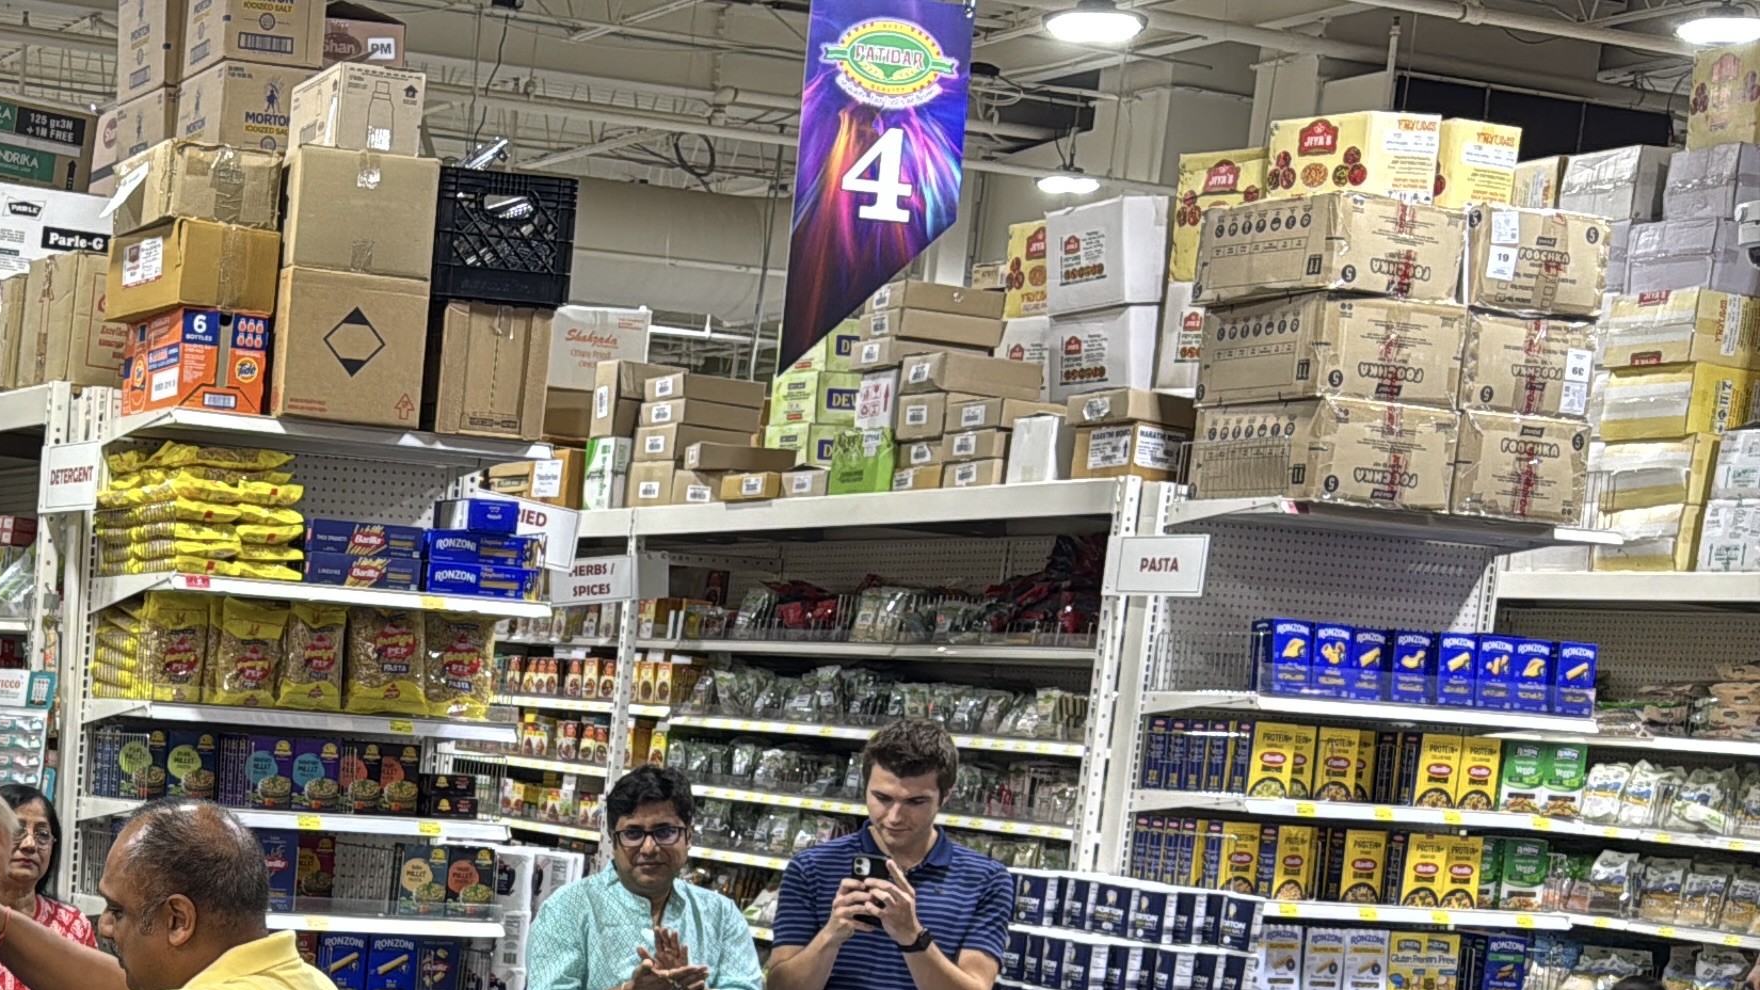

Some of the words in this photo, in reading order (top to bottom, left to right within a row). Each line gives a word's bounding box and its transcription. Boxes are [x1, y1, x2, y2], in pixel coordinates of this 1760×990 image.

[371, 42, 392, 55] PM
[854, 44, 925, 68] PATIDAR
[30, 112, 48, 125] 125
[245, 111, 290, 127] MORTO
[50, 129, 75, 143] FREE
[842, 128, 912, 223] 4
[10, 203, 40, 215] PARLE
[48, 232, 104, 250] Parle-G
[1519, 247, 1570, 264] FOOCHKA
[193, 314, 207, 333] 6
[185, 333, 213, 342] BOTTLES
[565, 328, 619, 346] Shahzada
[236, 360, 258, 377] Tide
[1358, 362, 1424, 383] FOOCHKA
[1512, 364, 1563, 380] FOOCHKA
[1501, 437, 1559, 458] FOOCHKA
[50, 464, 94, 486] DETERGENT
[518, 507, 548, 527] IED
[353, 534, 383, 546] Barilla
[436, 538, 476, 553] RONZONI
[569, 562, 608, 577] HERBS
[1140, 557, 1179, 572] PASTA
[351, 566, 380, 578] Barilla
[435, 570, 476, 584] RONZONI
[572, 583, 611, 597] SPICES
[1276, 622, 1310, 636] RONZONI
[1318, 628, 1350, 641] RONZONI
[1356, 632, 1386, 645] RONZONI
[1398, 635, 1430, 647] RONZONI
[1443, 637, 1476, 650] RONZONI
[1482, 640, 1514, 653] RONZONI
[1518, 644, 1550, 656] RONZONI
[1562, 647, 1595, 659] RONZONI
[384, 664, 407, 673] PASTA
[448, 681, 470, 690] PASTA
[1515, 765, 1536, 777] Veggie
[1555, 768, 1576, 779] Veggie
[1222, 919, 1246, 930] ORTON
[325, 936, 365, 948] RONZONI
[1266, 930, 1299, 942] RONZONI
[1350, 933, 1385, 945] RONZONI
[374, 938, 415, 951] RONZONI
[1490, 940, 1525, 952] RONZONI
